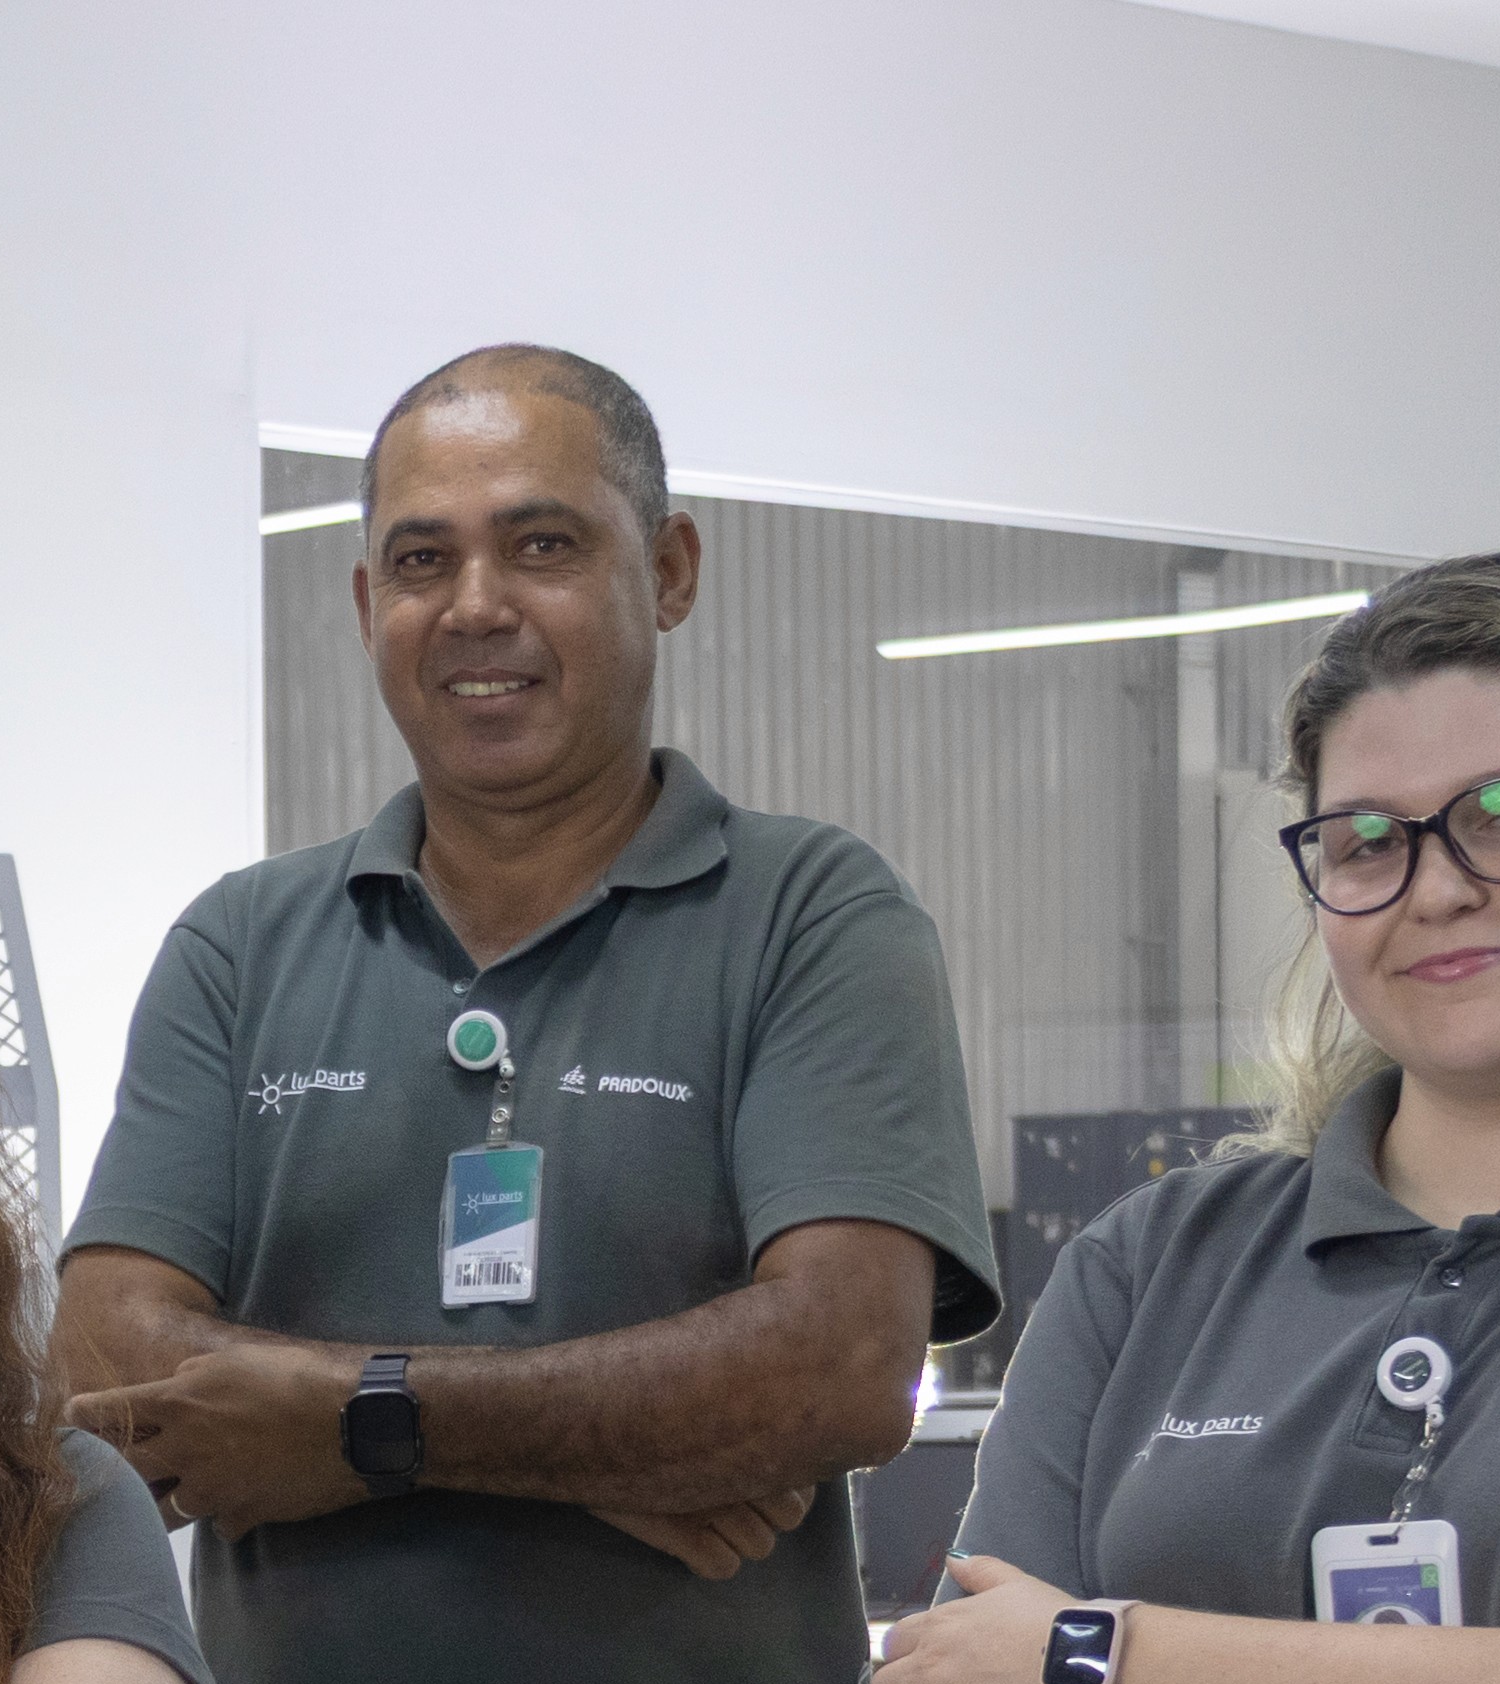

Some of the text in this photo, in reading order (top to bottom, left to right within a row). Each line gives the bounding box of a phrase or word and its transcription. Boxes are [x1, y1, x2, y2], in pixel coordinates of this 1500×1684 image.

[290, 1069, 366, 1091] lu parts
[481, 1191, 523, 1202] lux parts
[1160, 1412, 1264, 1435] lux parts
